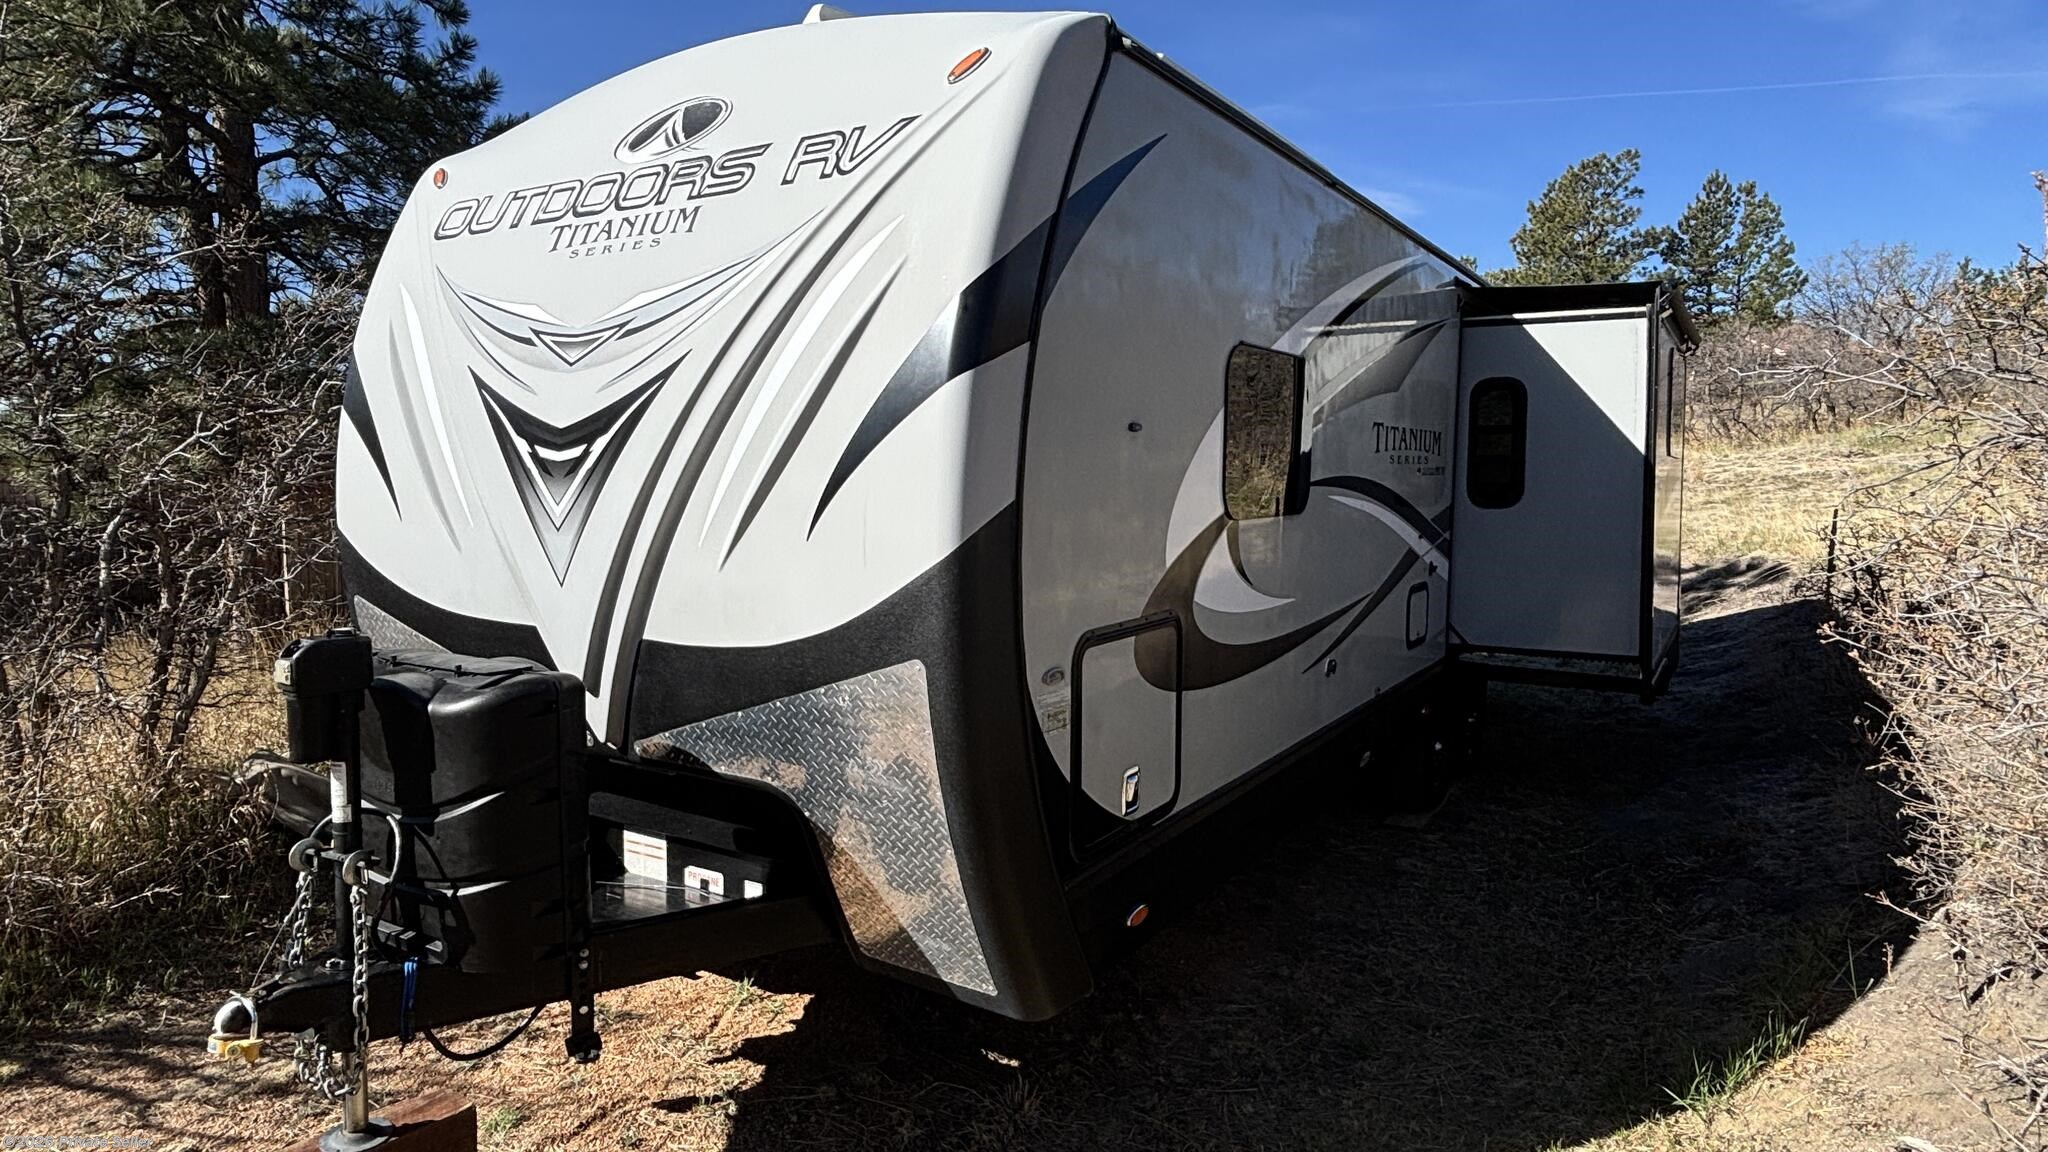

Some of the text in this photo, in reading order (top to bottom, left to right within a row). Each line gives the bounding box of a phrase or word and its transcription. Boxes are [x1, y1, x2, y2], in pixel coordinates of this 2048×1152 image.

[434, 114, 922, 240] OUTDOORS RV
[548, 205, 702, 253] TITANIUM
[569, 237, 661, 259] SERIES
[1372, 421, 1442, 456] TITANIUM
[1389, 455, 1429, 465] SERIES
